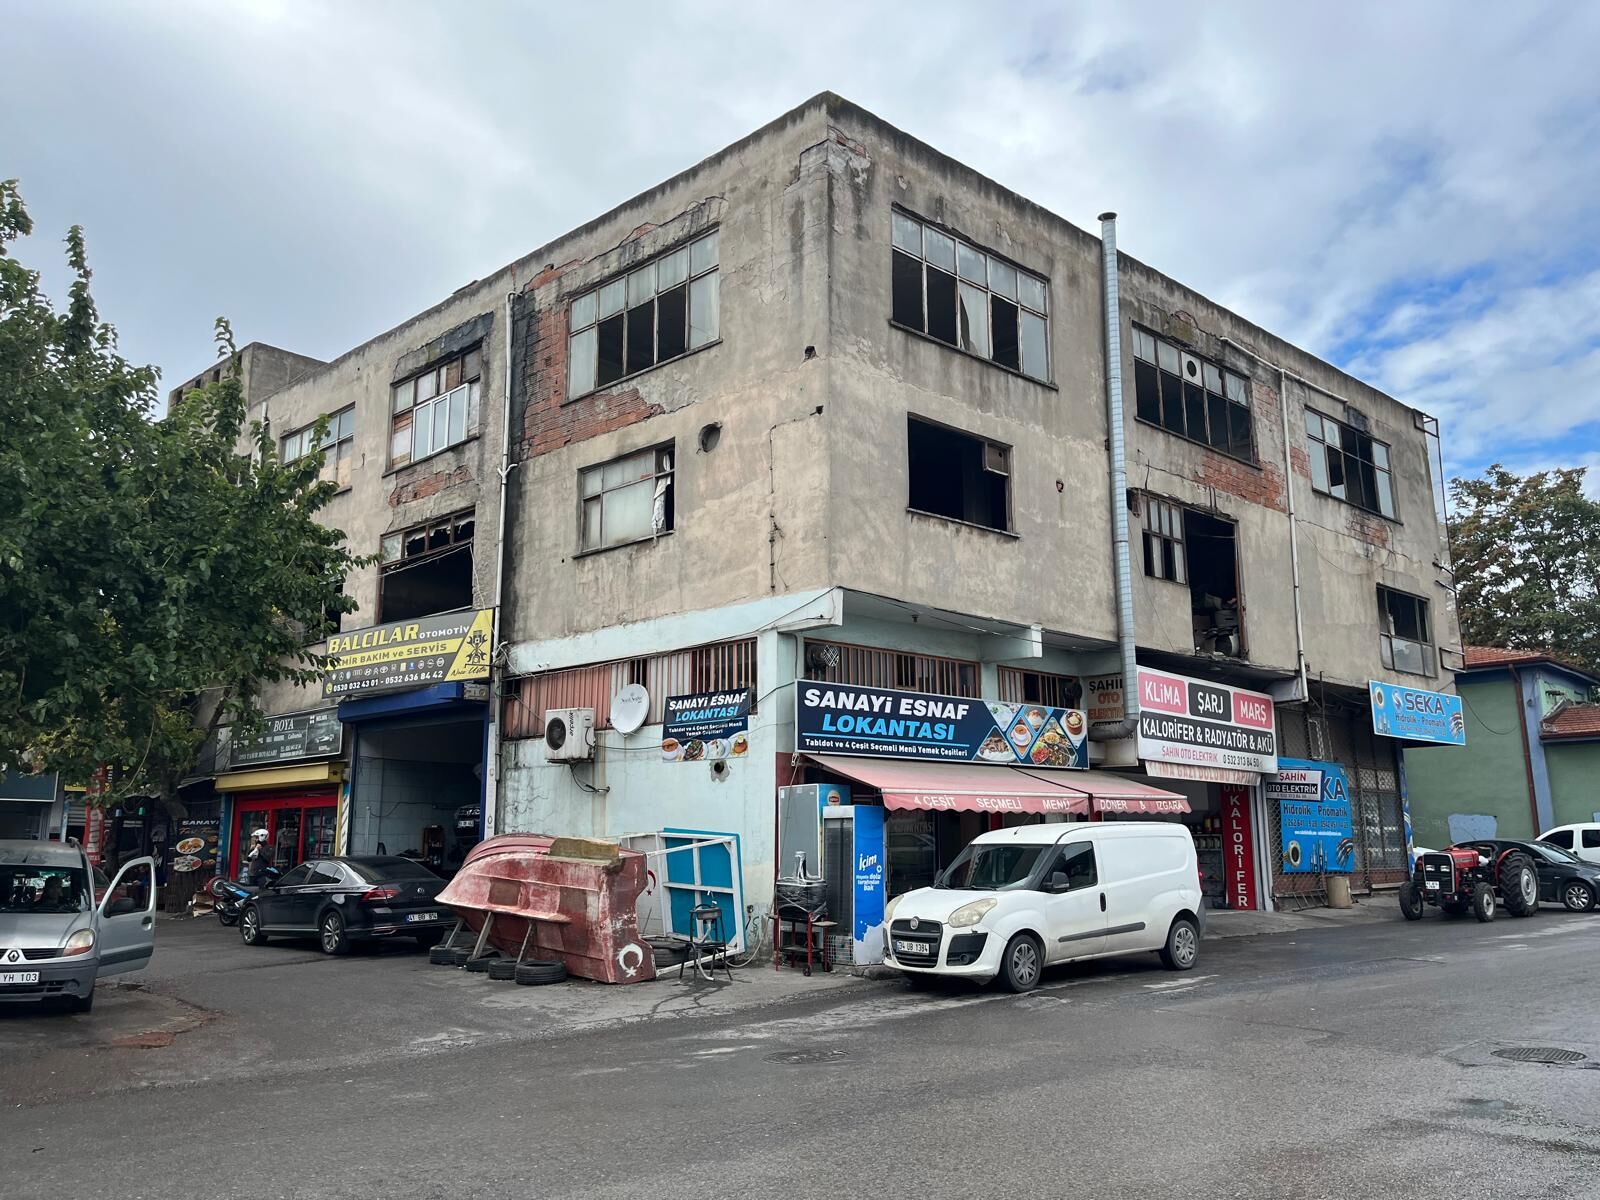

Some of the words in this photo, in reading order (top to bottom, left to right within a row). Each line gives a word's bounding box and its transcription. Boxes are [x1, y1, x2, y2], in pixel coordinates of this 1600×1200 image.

[328, 624, 419, 654] BALCILAR
[420, 625, 470, 638] OTOMOTİV
[360, 652, 390, 662] BAKIM
[407, 643, 447, 655] SERVİS
[386, 676, 402, 684] 0532
[710, 693, 747, 706] ESNAF
[1404, 692, 1446, 716] SEKA
[676, 706, 738, 722] LOKANTASI
[899, 698, 970, 720] ESNAF
[1198, 692, 1224, 714] ŞARJ
[1240, 700, 1266, 724] MARŞ
[273, 718, 294, 732] BOYA
[822, 713, 954, 740] LOKANTASI
[1143, 718, 1194, 741] KALORİFER
[1197, 726, 1202, 742] &
[1205, 728, 1248, 748] RADYATÖR
[1250, 735, 1255, 750] &
[1257, 734, 1272, 752] AKÜ
[851, 742, 869, 750] Çeşit
[870, 743, 898, 752] Seçmeli
[899, 744, 917, 753] Menü
[918, 746, 940, 755] Yemek
[1280, 771, 1306, 782] ŞAHİN
[1282, 784, 1317, 794] ELEKTRİK
[923, 795, 956, 808] ÇEŞİT
[976, 797, 1022, 810] SEÇMELİ
[1042, 798, 1070, 810] MENÜ
[4, 974, 14, 982] YH
[21, 974, 37, 982] 103
